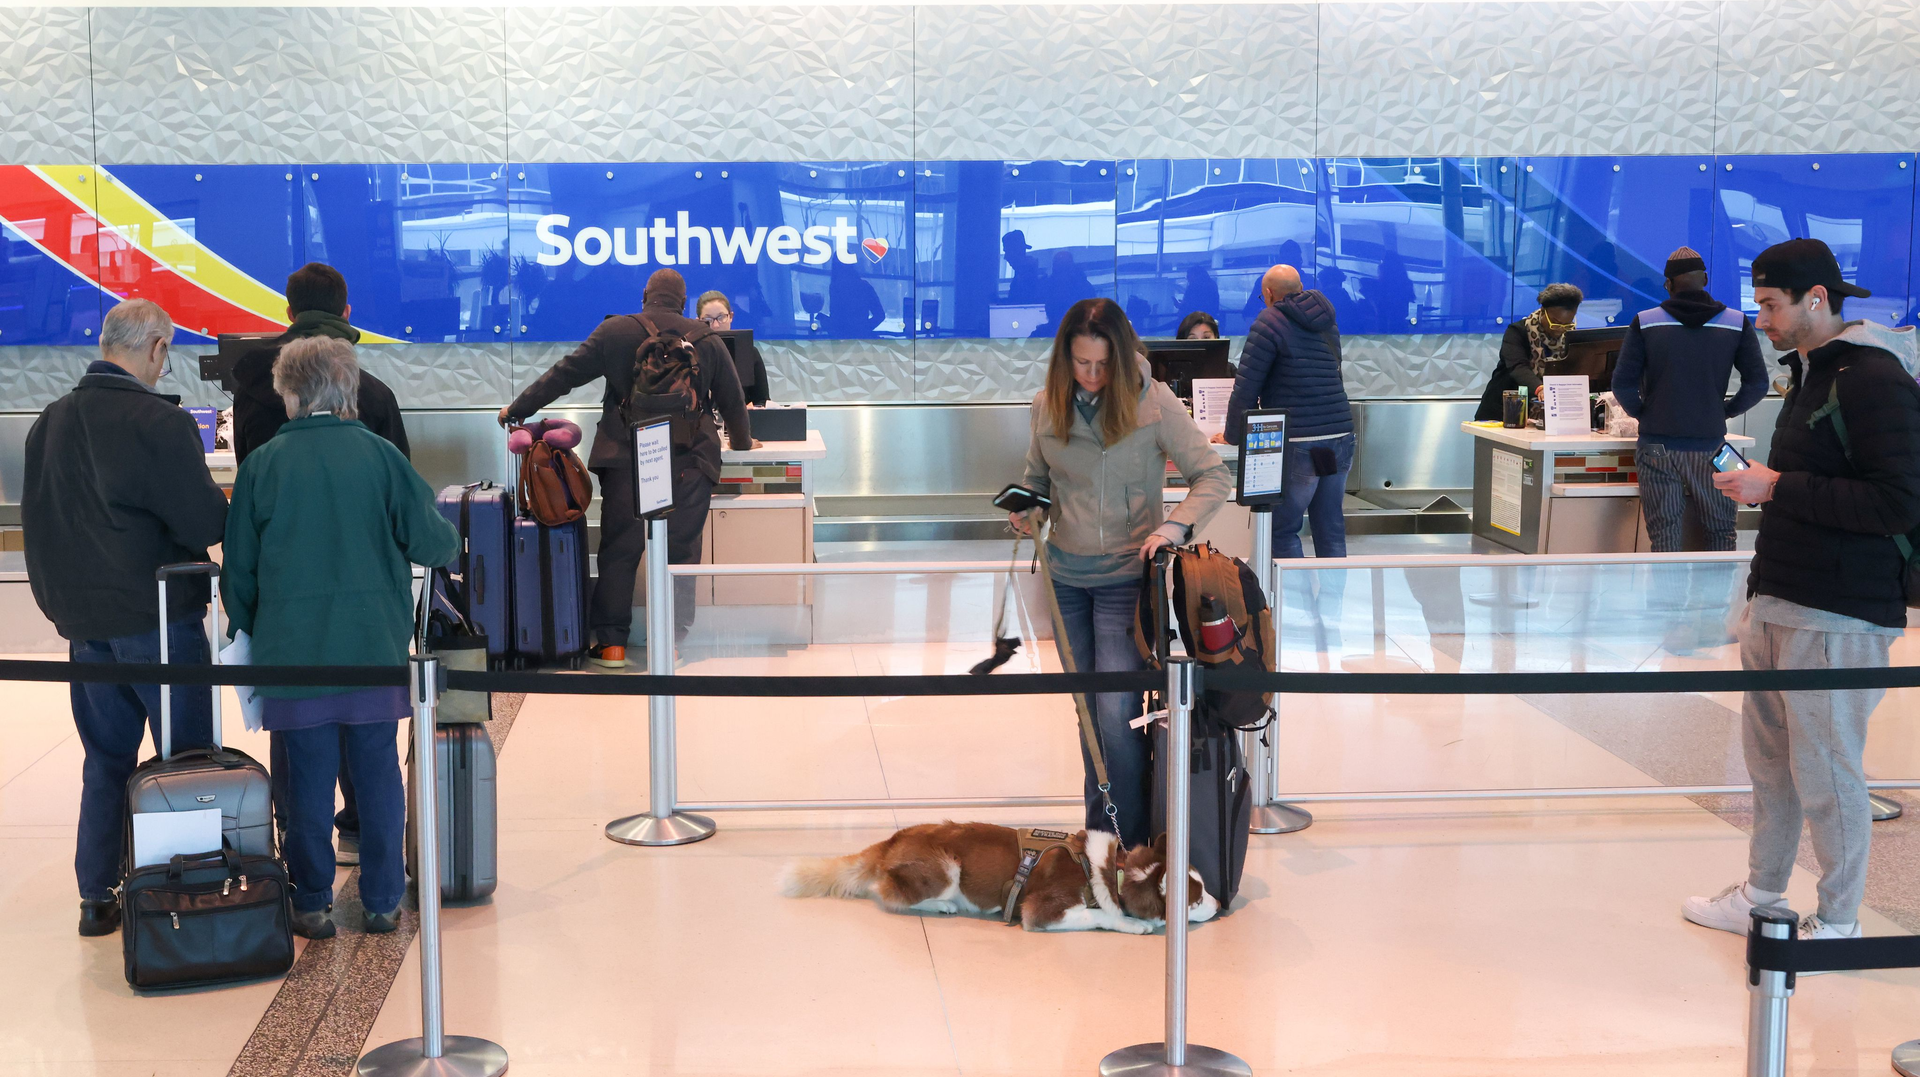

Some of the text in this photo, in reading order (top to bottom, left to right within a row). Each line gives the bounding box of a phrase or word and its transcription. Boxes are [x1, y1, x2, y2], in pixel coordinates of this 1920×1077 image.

[535, 211, 858, 266] Southwest
[657, 445, 668, 453] called
[641, 476, 652, 484] Thank
